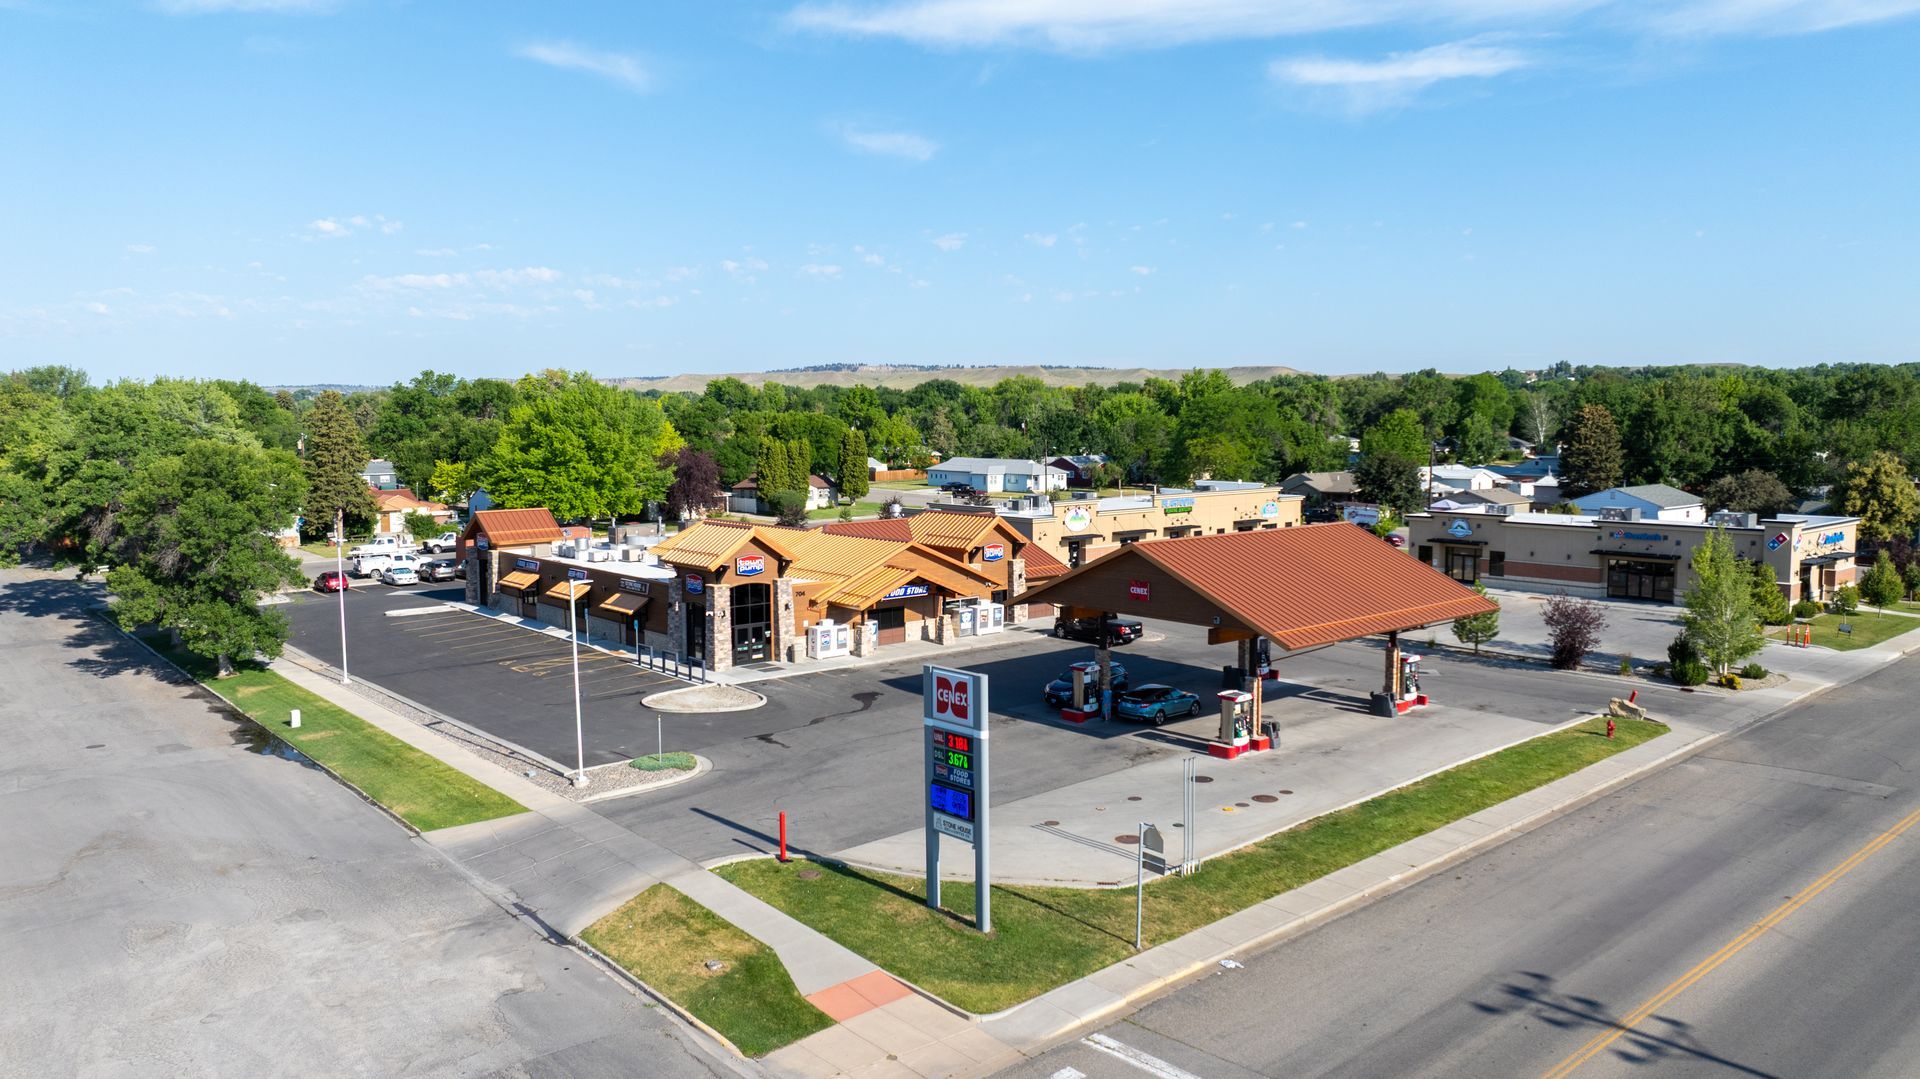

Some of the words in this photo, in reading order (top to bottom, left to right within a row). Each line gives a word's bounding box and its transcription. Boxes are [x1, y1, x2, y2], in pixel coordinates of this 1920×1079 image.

[739, 558, 764, 566] town
[740, 564, 763, 573] pump
[887, 587, 905, 597] OOD
[906, 585, 928, 595] STORE
[1130, 586, 1148, 595] CENEX
[937, 688, 967, 707] CENEX
[953, 768, 969, 778] FOOD
[950, 774, 971, 786] STORES
